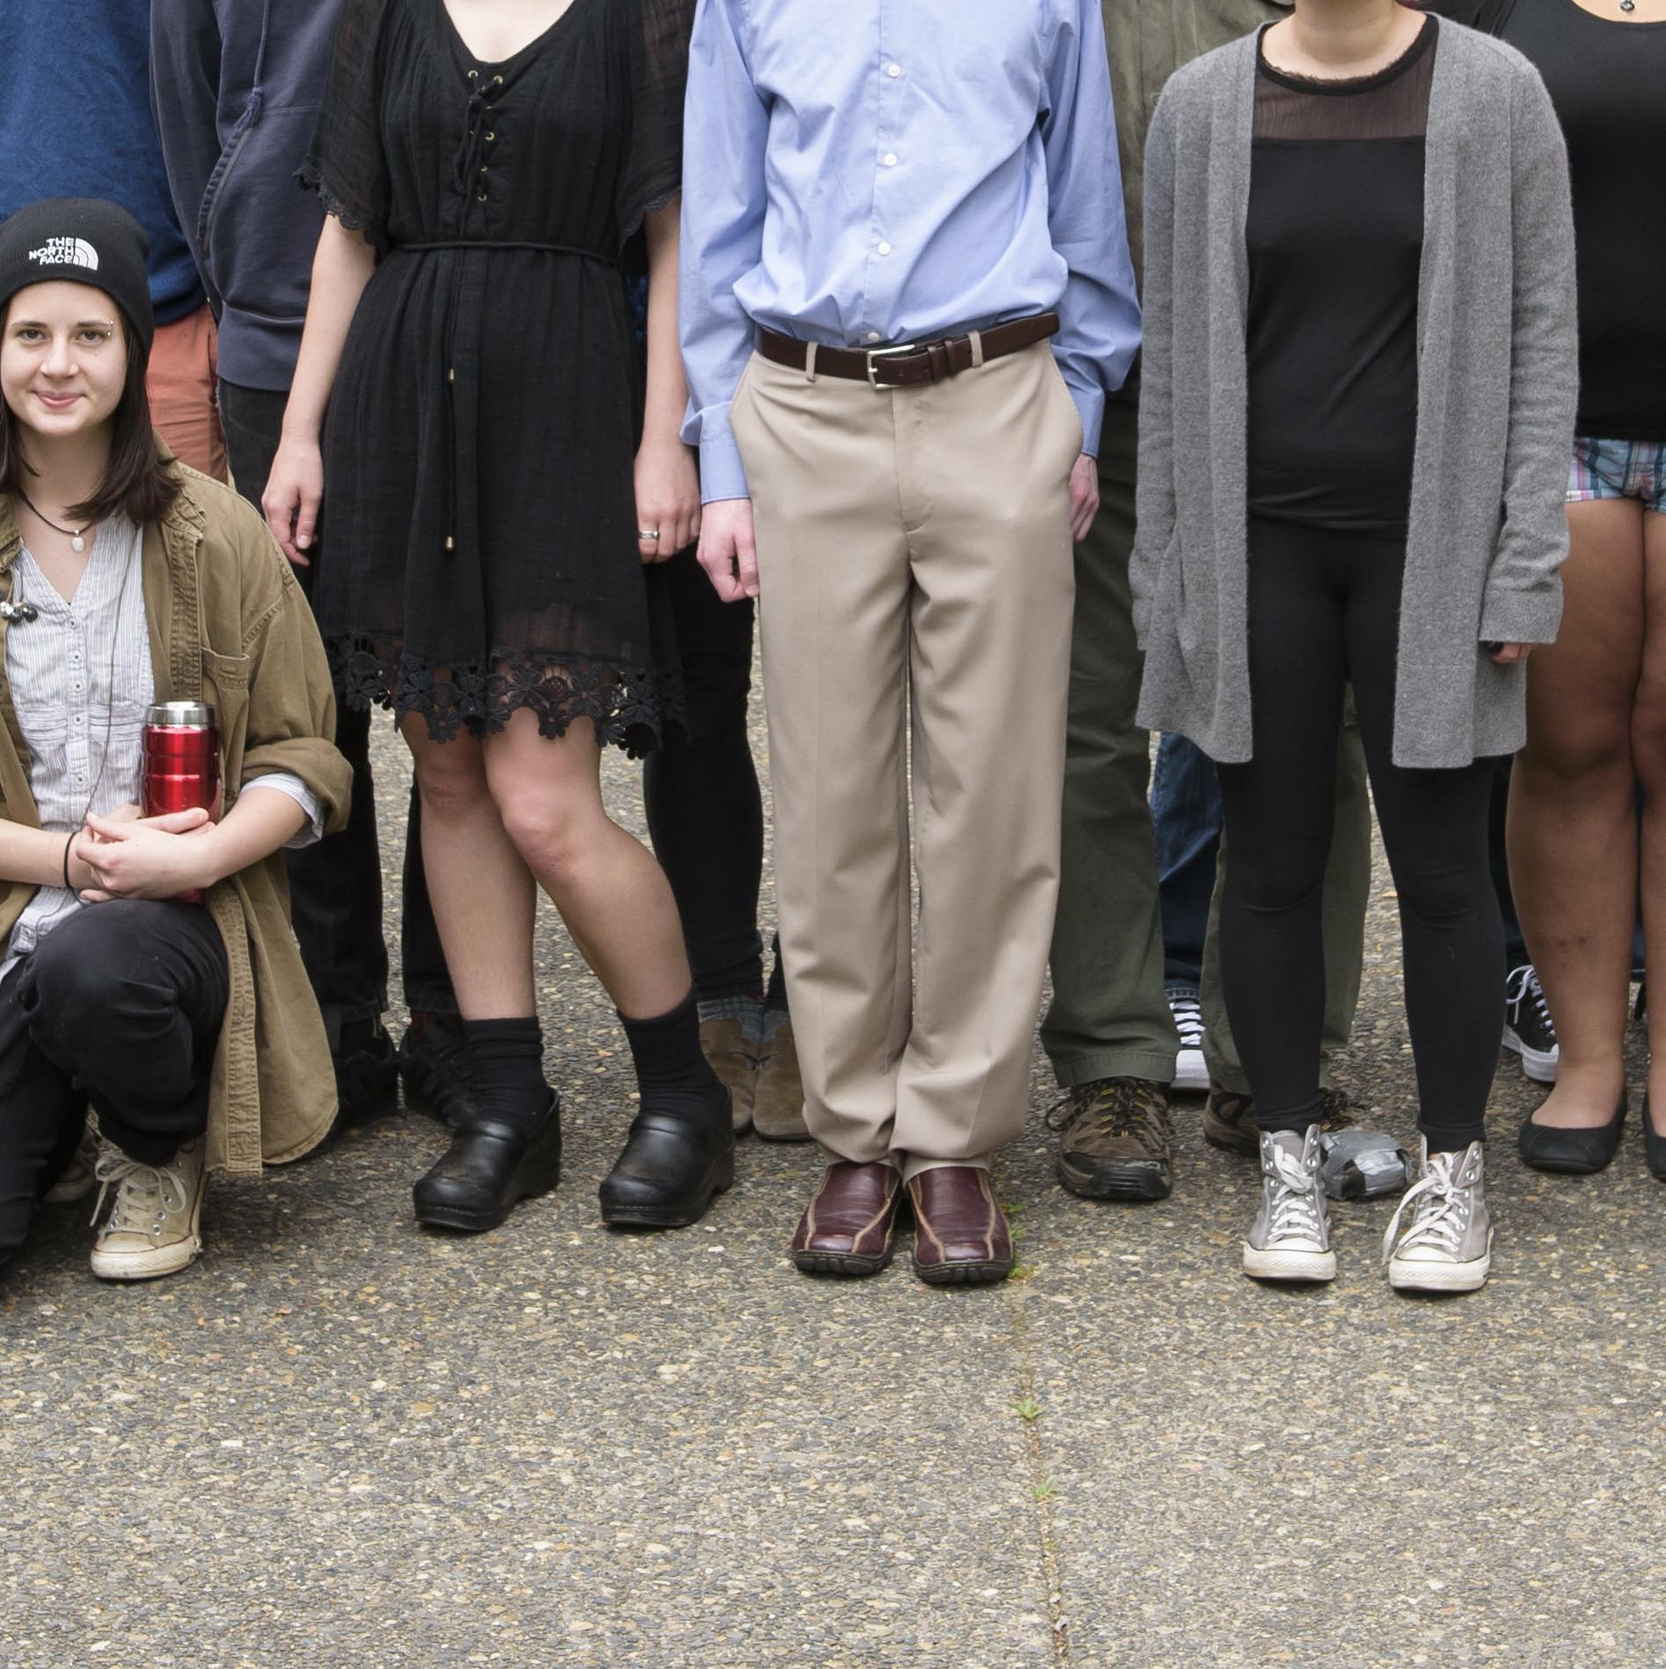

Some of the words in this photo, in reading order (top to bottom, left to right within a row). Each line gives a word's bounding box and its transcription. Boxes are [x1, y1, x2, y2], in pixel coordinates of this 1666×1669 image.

[46, 236, 75, 247] THE
[28, 246, 74, 261] NORTH
[39, 254, 73, 266] FACE
